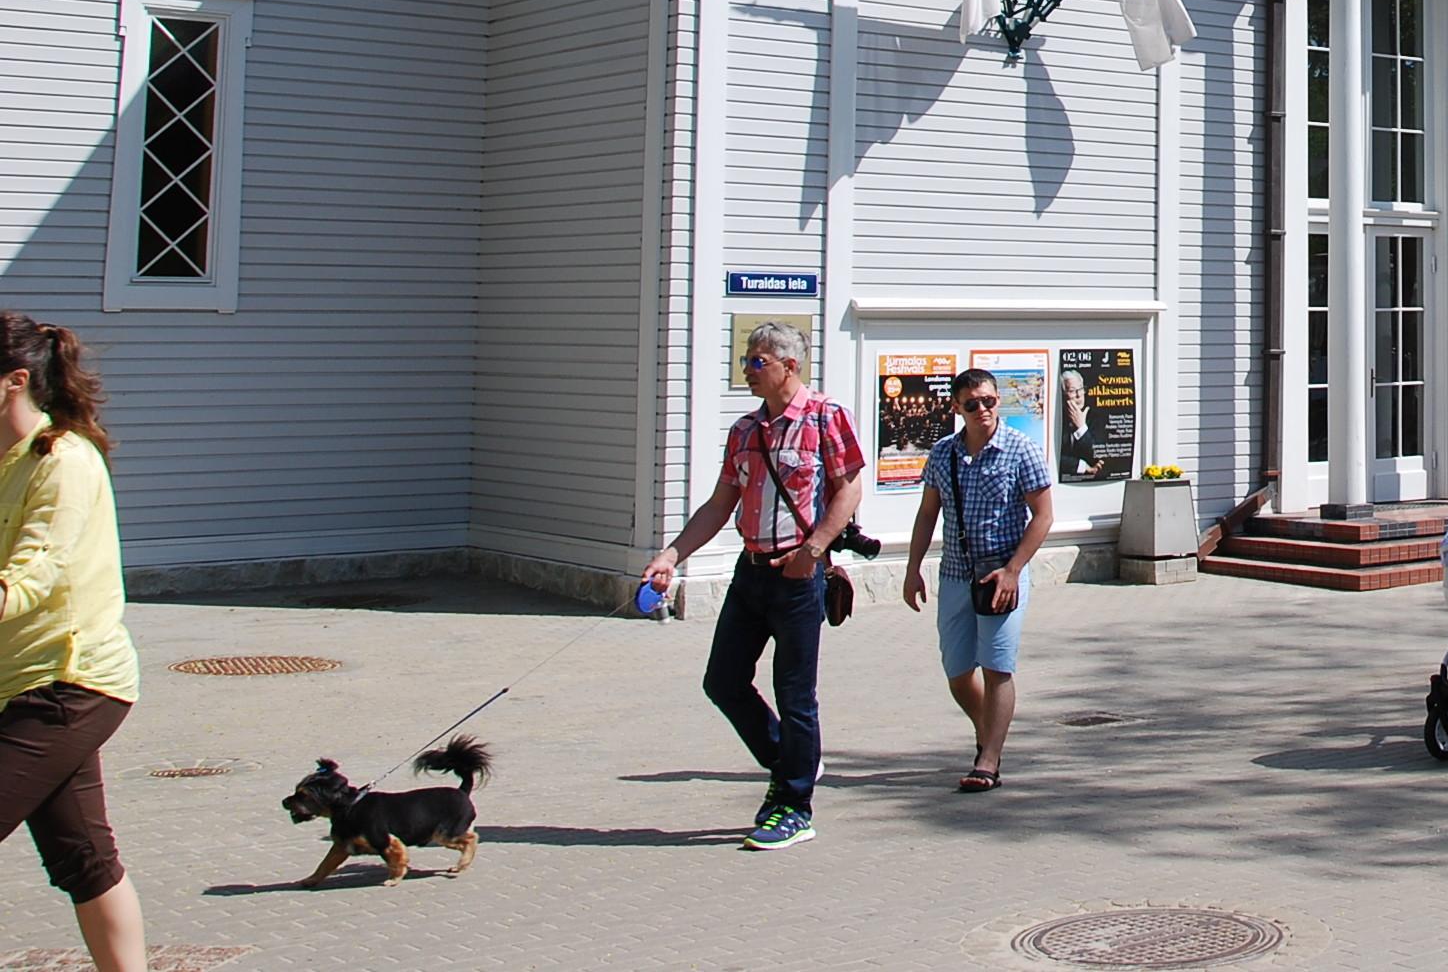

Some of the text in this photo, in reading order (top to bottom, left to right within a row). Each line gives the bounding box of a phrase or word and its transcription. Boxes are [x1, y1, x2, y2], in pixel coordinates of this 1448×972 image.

[740, 276, 808, 290] Turaidas iela
[1098, 374, 1133, 385] Sezonas
[1096, 396, 1134, 407] koncerts
